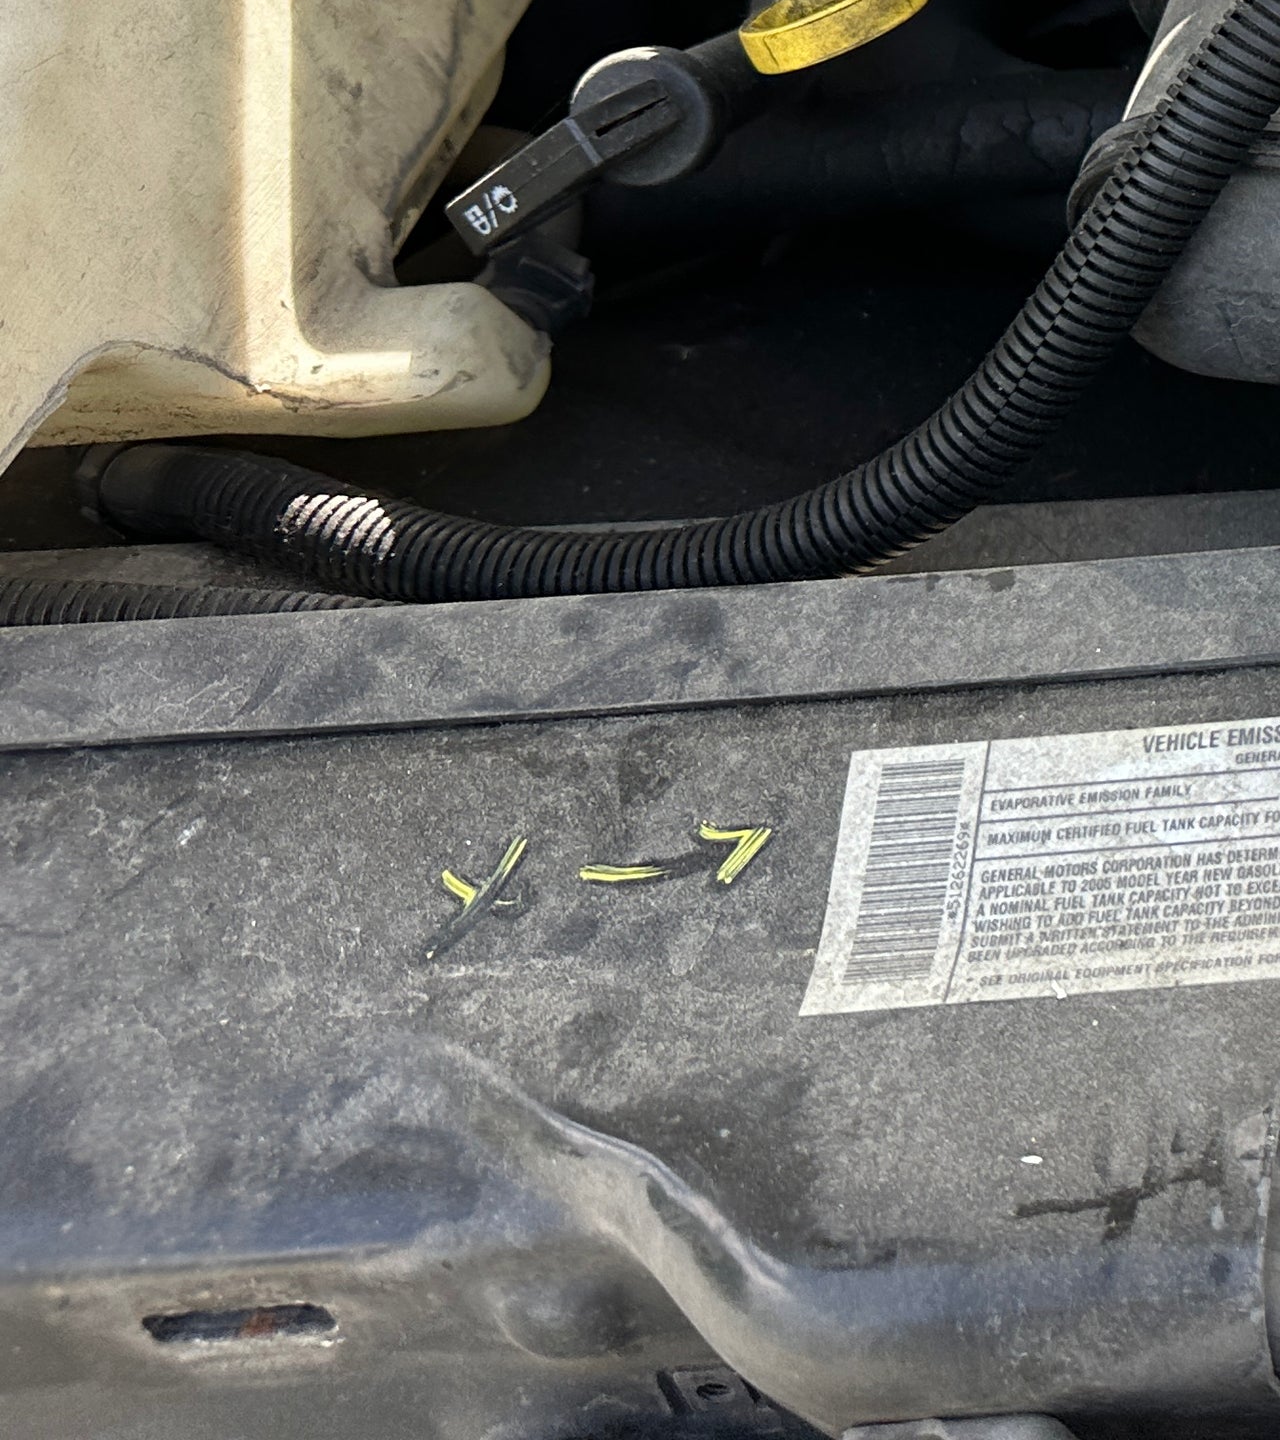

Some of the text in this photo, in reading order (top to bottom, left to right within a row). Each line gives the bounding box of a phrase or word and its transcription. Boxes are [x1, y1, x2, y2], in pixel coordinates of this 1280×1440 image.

[1141, 729, 1221, 753] VEHICLE
[989, 783, 1193, 812] EVAPORATIVE EMISSION FAMILY
[986, 829, 1052, 846] MAXIMUM
[1055, 823, 1121, 841] CERTIFIED
[1125, 820, 1157, 835] FUEL
[1161, 817, 1196, 832] TANK
[1198, 811, 1259, 828] CAPACITY
[977, 881, 1055, 900] APPLICABLE
[1060, 879, 1076, 893] TO
[1080, 876, 1111, 891] 2005
[1116, 872, 1160, 888] MODEL
[1165, 868, 1198, 884] YEAR
[1203, 866, 1232, 881] NEW
[979, 866, 1038, 884] GENERAL
[1043, 861, 1098, 878] MOTORS
[1101, 853, 1191, 873] CORPORATION
[1196, 850, 1223, 865] HAS
[972, 916, 1031, 933] WISHING
[1035, 914, 1053, 928] TO
[1057, 911, 1083, 926] ADD
[1087, 908, 1121, 924] FUEL
[1124, 905, 1159, 920] TANK
[1162, 899, 1225, 917] CAPACITY
[975, 903, 986, 917] A
[989, 897, 1050, 916] NOMINAL
[1053, 894, 1087, 910] FUEL
[1091, 891, 1125, 907] TANK
[1128, 885, 1190, 904] CAPACITY
[1195, 883, 1221, 898] NOT
[1224, 881, 1242, 896] TO
